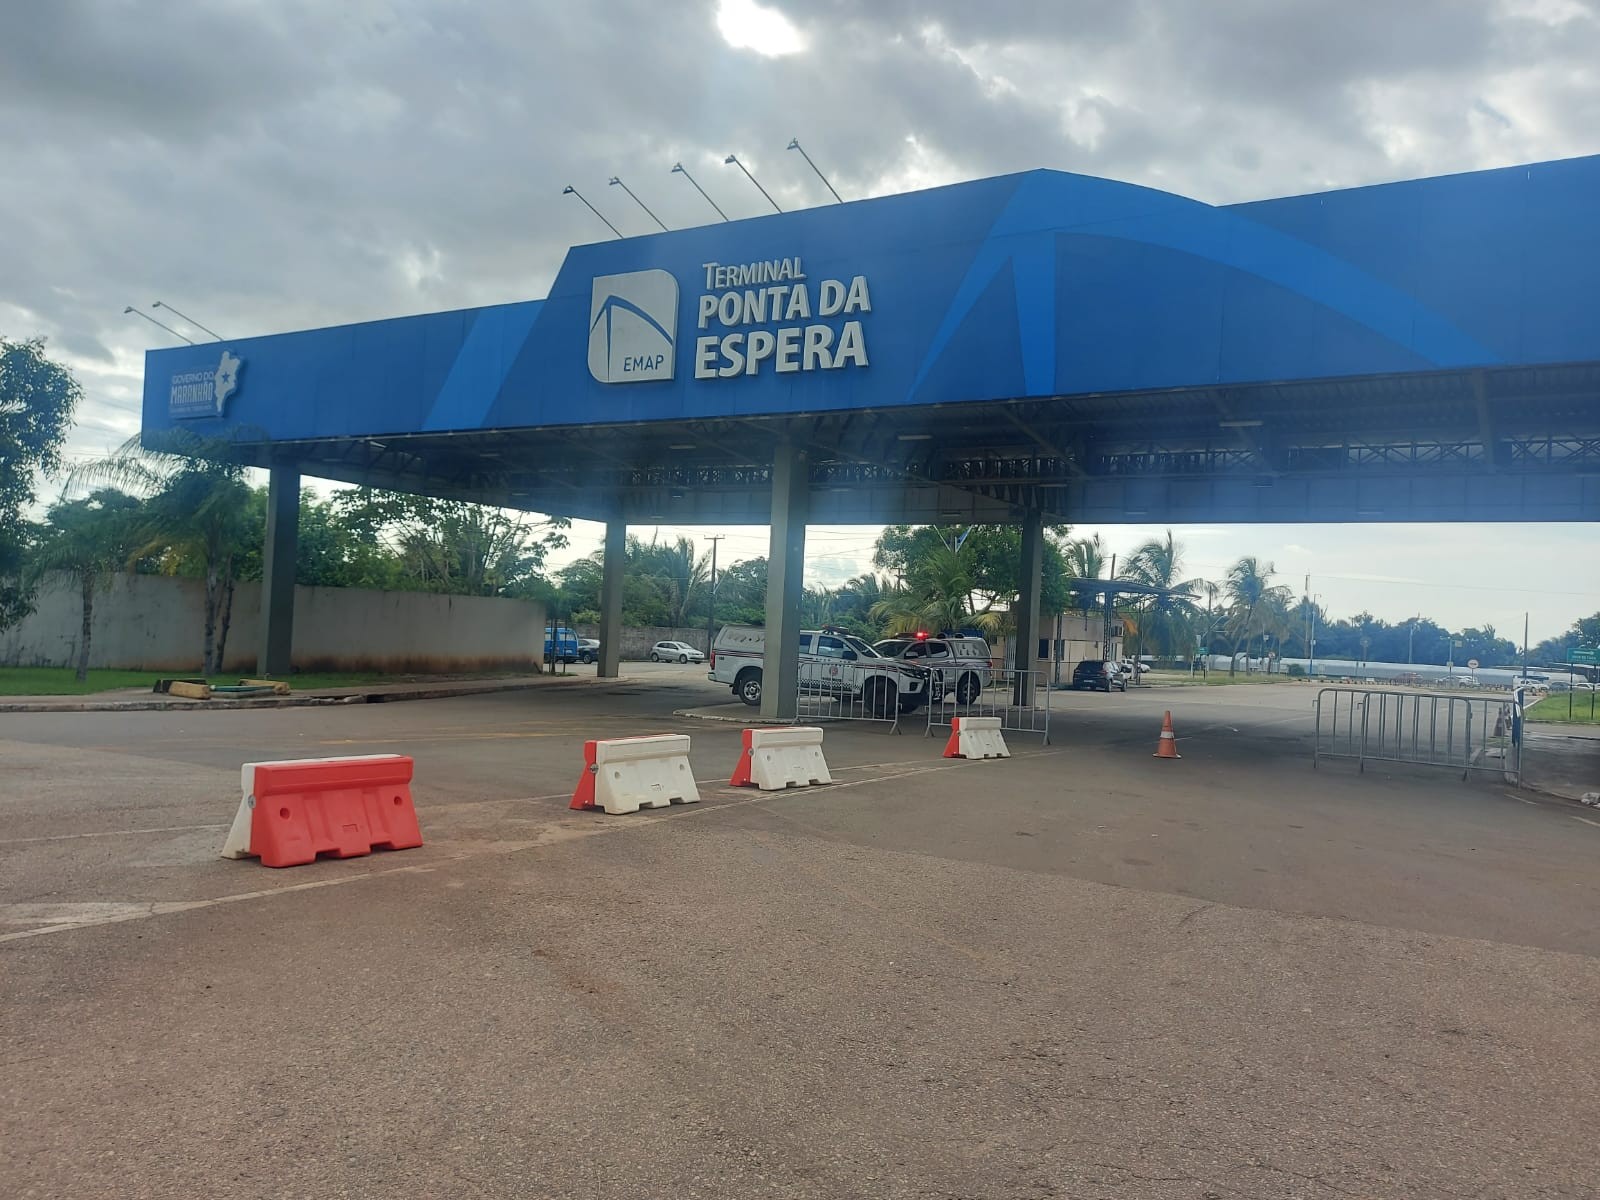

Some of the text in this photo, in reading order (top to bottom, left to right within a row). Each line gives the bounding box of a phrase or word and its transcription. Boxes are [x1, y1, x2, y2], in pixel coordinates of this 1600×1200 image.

[703, 257, 807, 289] TERMINAL
[698, 275, 871, 328] PONTA DA
[623, 354, 664, 372] EMAP
[695, 321, 869, 379] ESPERA
[172, 371, 214, 384] GOVERNO DO
[170, 382, 213, 404] MARANHÃO
